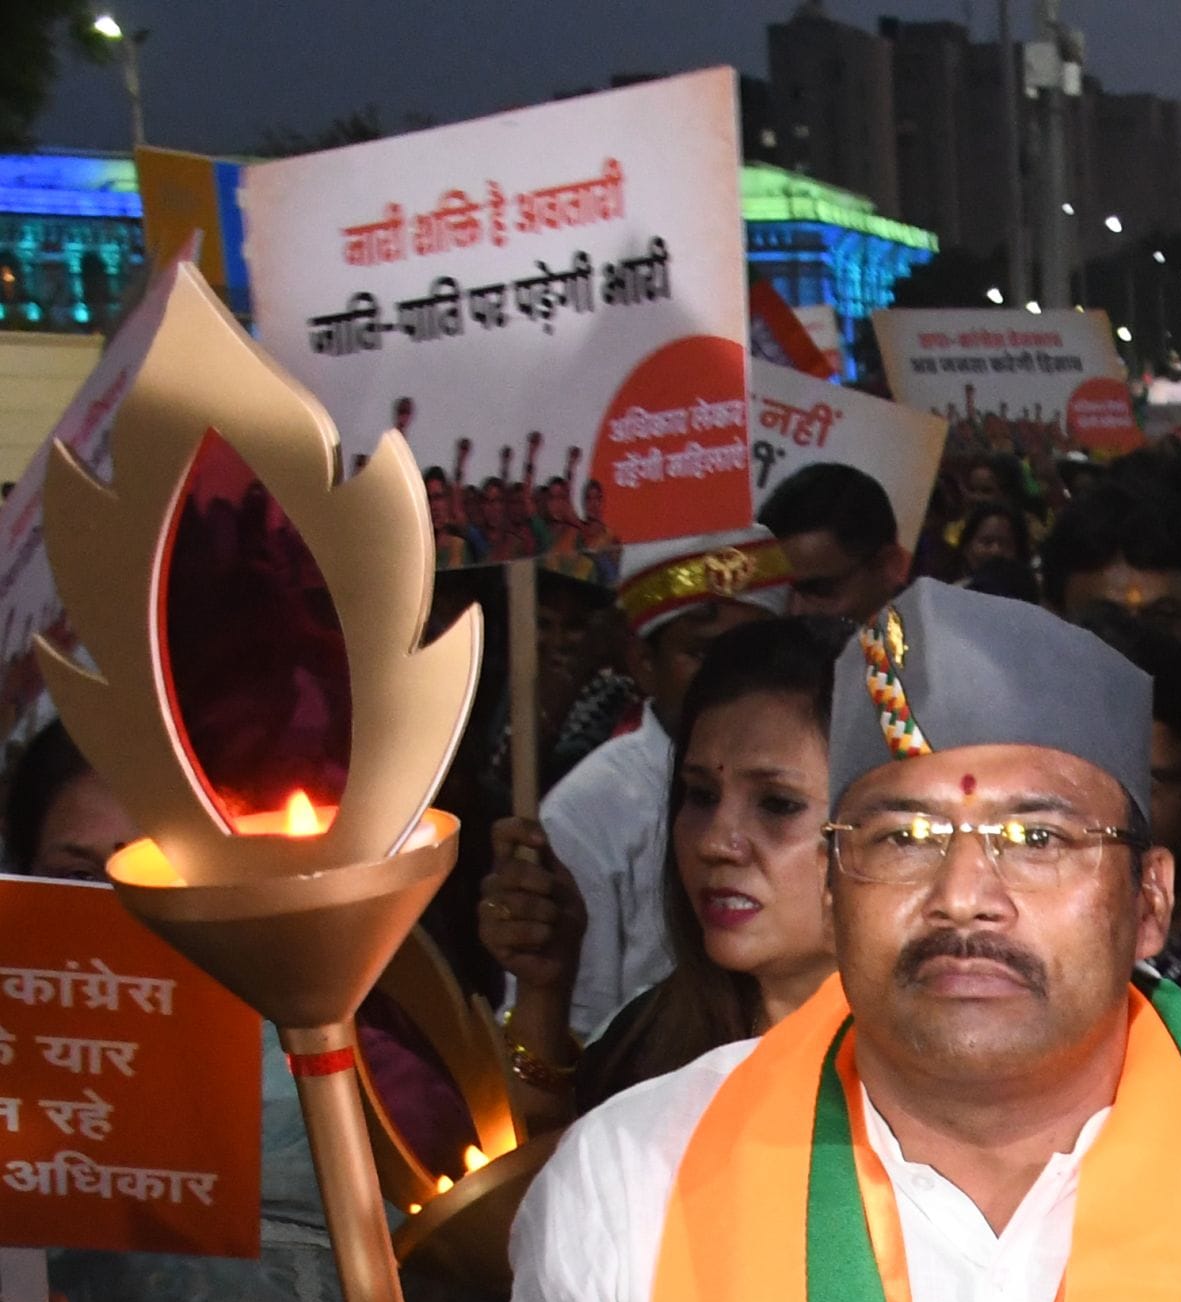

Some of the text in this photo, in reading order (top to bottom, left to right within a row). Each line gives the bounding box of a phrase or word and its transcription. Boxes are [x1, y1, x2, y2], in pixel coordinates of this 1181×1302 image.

[342, 202, 405, 266] नारी
[412, 188, 481, 257] शक्ति
[484, 178, 509, 248] है
[467, 283, 510, 330] पर
[510, 250, 594, 336] पड़ेगी
[601, 236, 671, 306] भारी
[759, 397, 844, 448] नहीं
[0, 957, 177, 1017] कांग्रेस
[35, 1035, 140, 1078] यार
[38, 1088, 114, 1142] रहे
[3, 1149, 219, 1206] अधिकार
